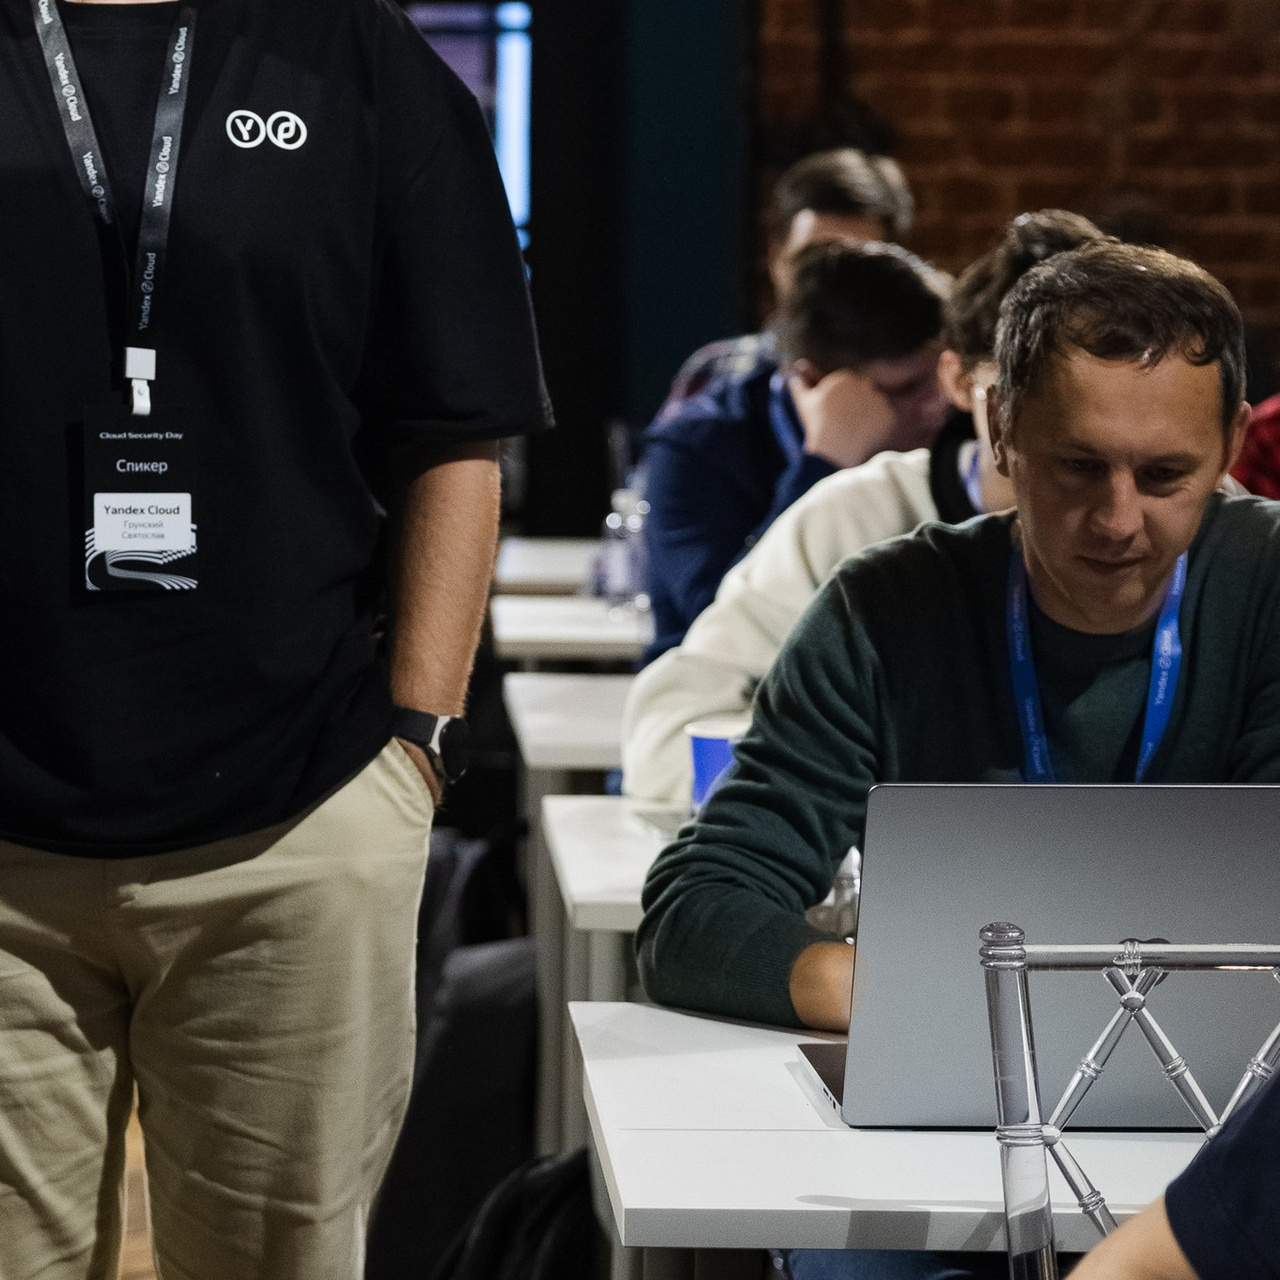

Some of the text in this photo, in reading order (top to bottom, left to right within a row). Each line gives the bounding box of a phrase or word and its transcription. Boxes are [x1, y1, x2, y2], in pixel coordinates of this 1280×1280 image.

[54, 52, 82, 121] Yandex Cloud
[168, 27, 188, 95] Yandex Cloud
[82, 151, 98, 185] Yandex
[152, 136, 173, 208] Yandex Cloud
[139, 252, 157, 330] Yandex Cloud
[99, 431, 183, 440] Cloud Security Day
[116, 459, 169, 475] Спикер
[104, 504, 180, 515] Yandex Cloud
